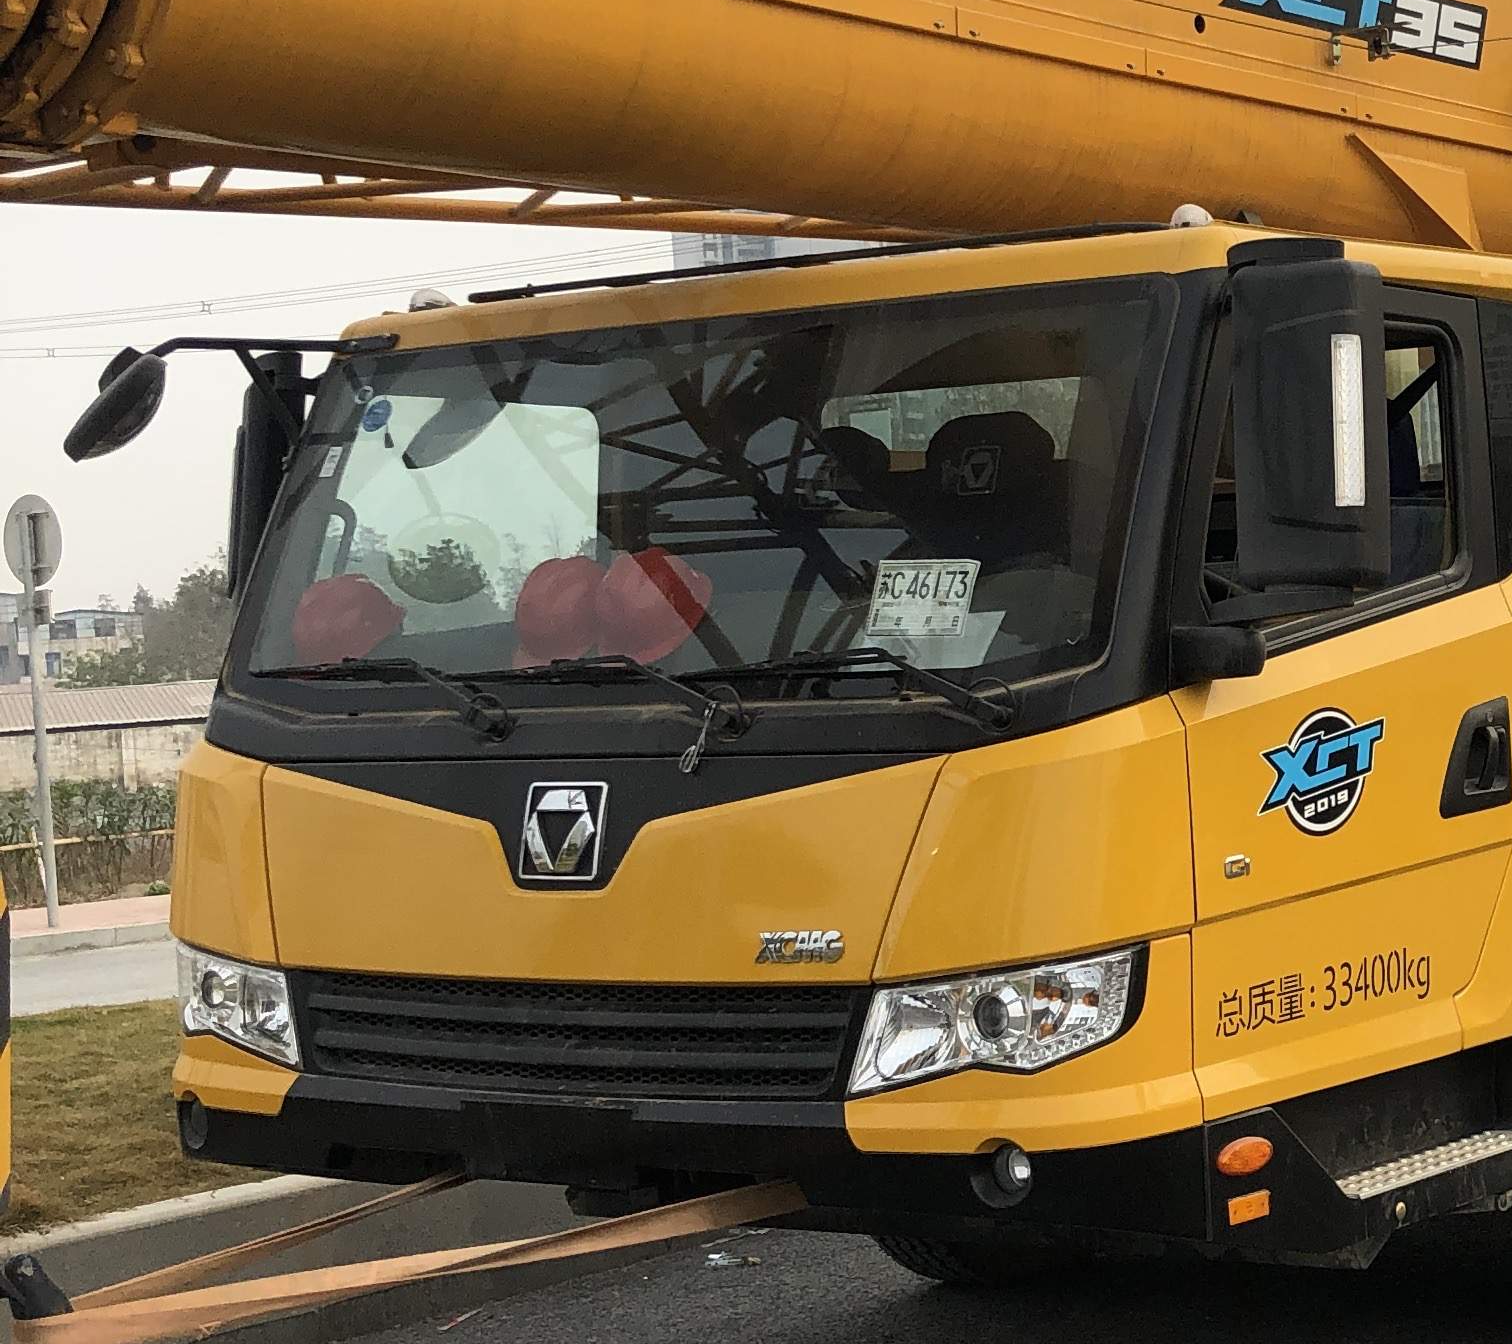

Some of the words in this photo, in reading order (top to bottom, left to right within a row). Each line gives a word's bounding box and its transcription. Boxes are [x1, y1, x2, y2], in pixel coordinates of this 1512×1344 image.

[878, 570, 970, 599] 苏C46173
[1267, 725, 1382, 805] XCT
[1303, 789, 1349, 818] 2019
